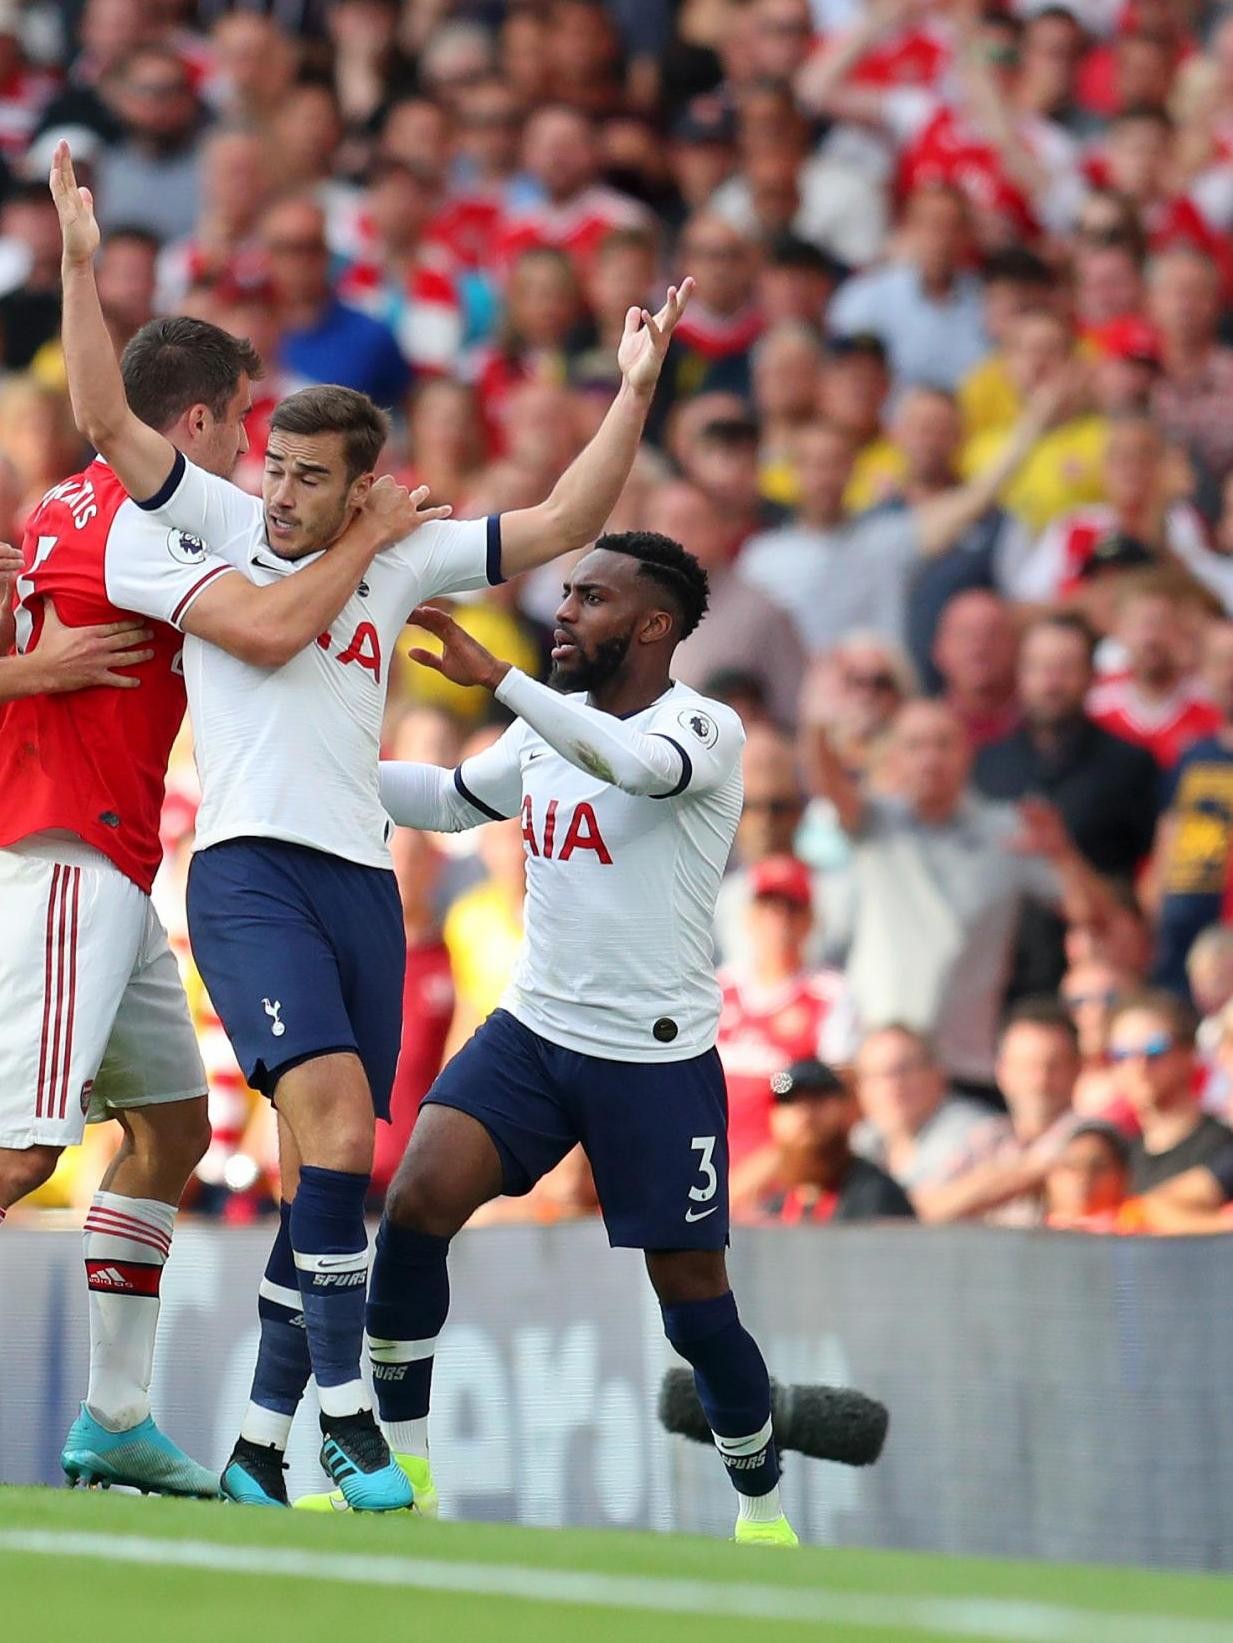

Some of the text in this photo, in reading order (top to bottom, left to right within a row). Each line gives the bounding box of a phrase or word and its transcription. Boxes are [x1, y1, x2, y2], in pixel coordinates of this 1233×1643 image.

[521, 793, 614, 866] AIA
[688, 1136, 717, 1202] 3
[312, 1269, 367, 1288] SPURS
[720, 1448, 767, 1470] SPURS
